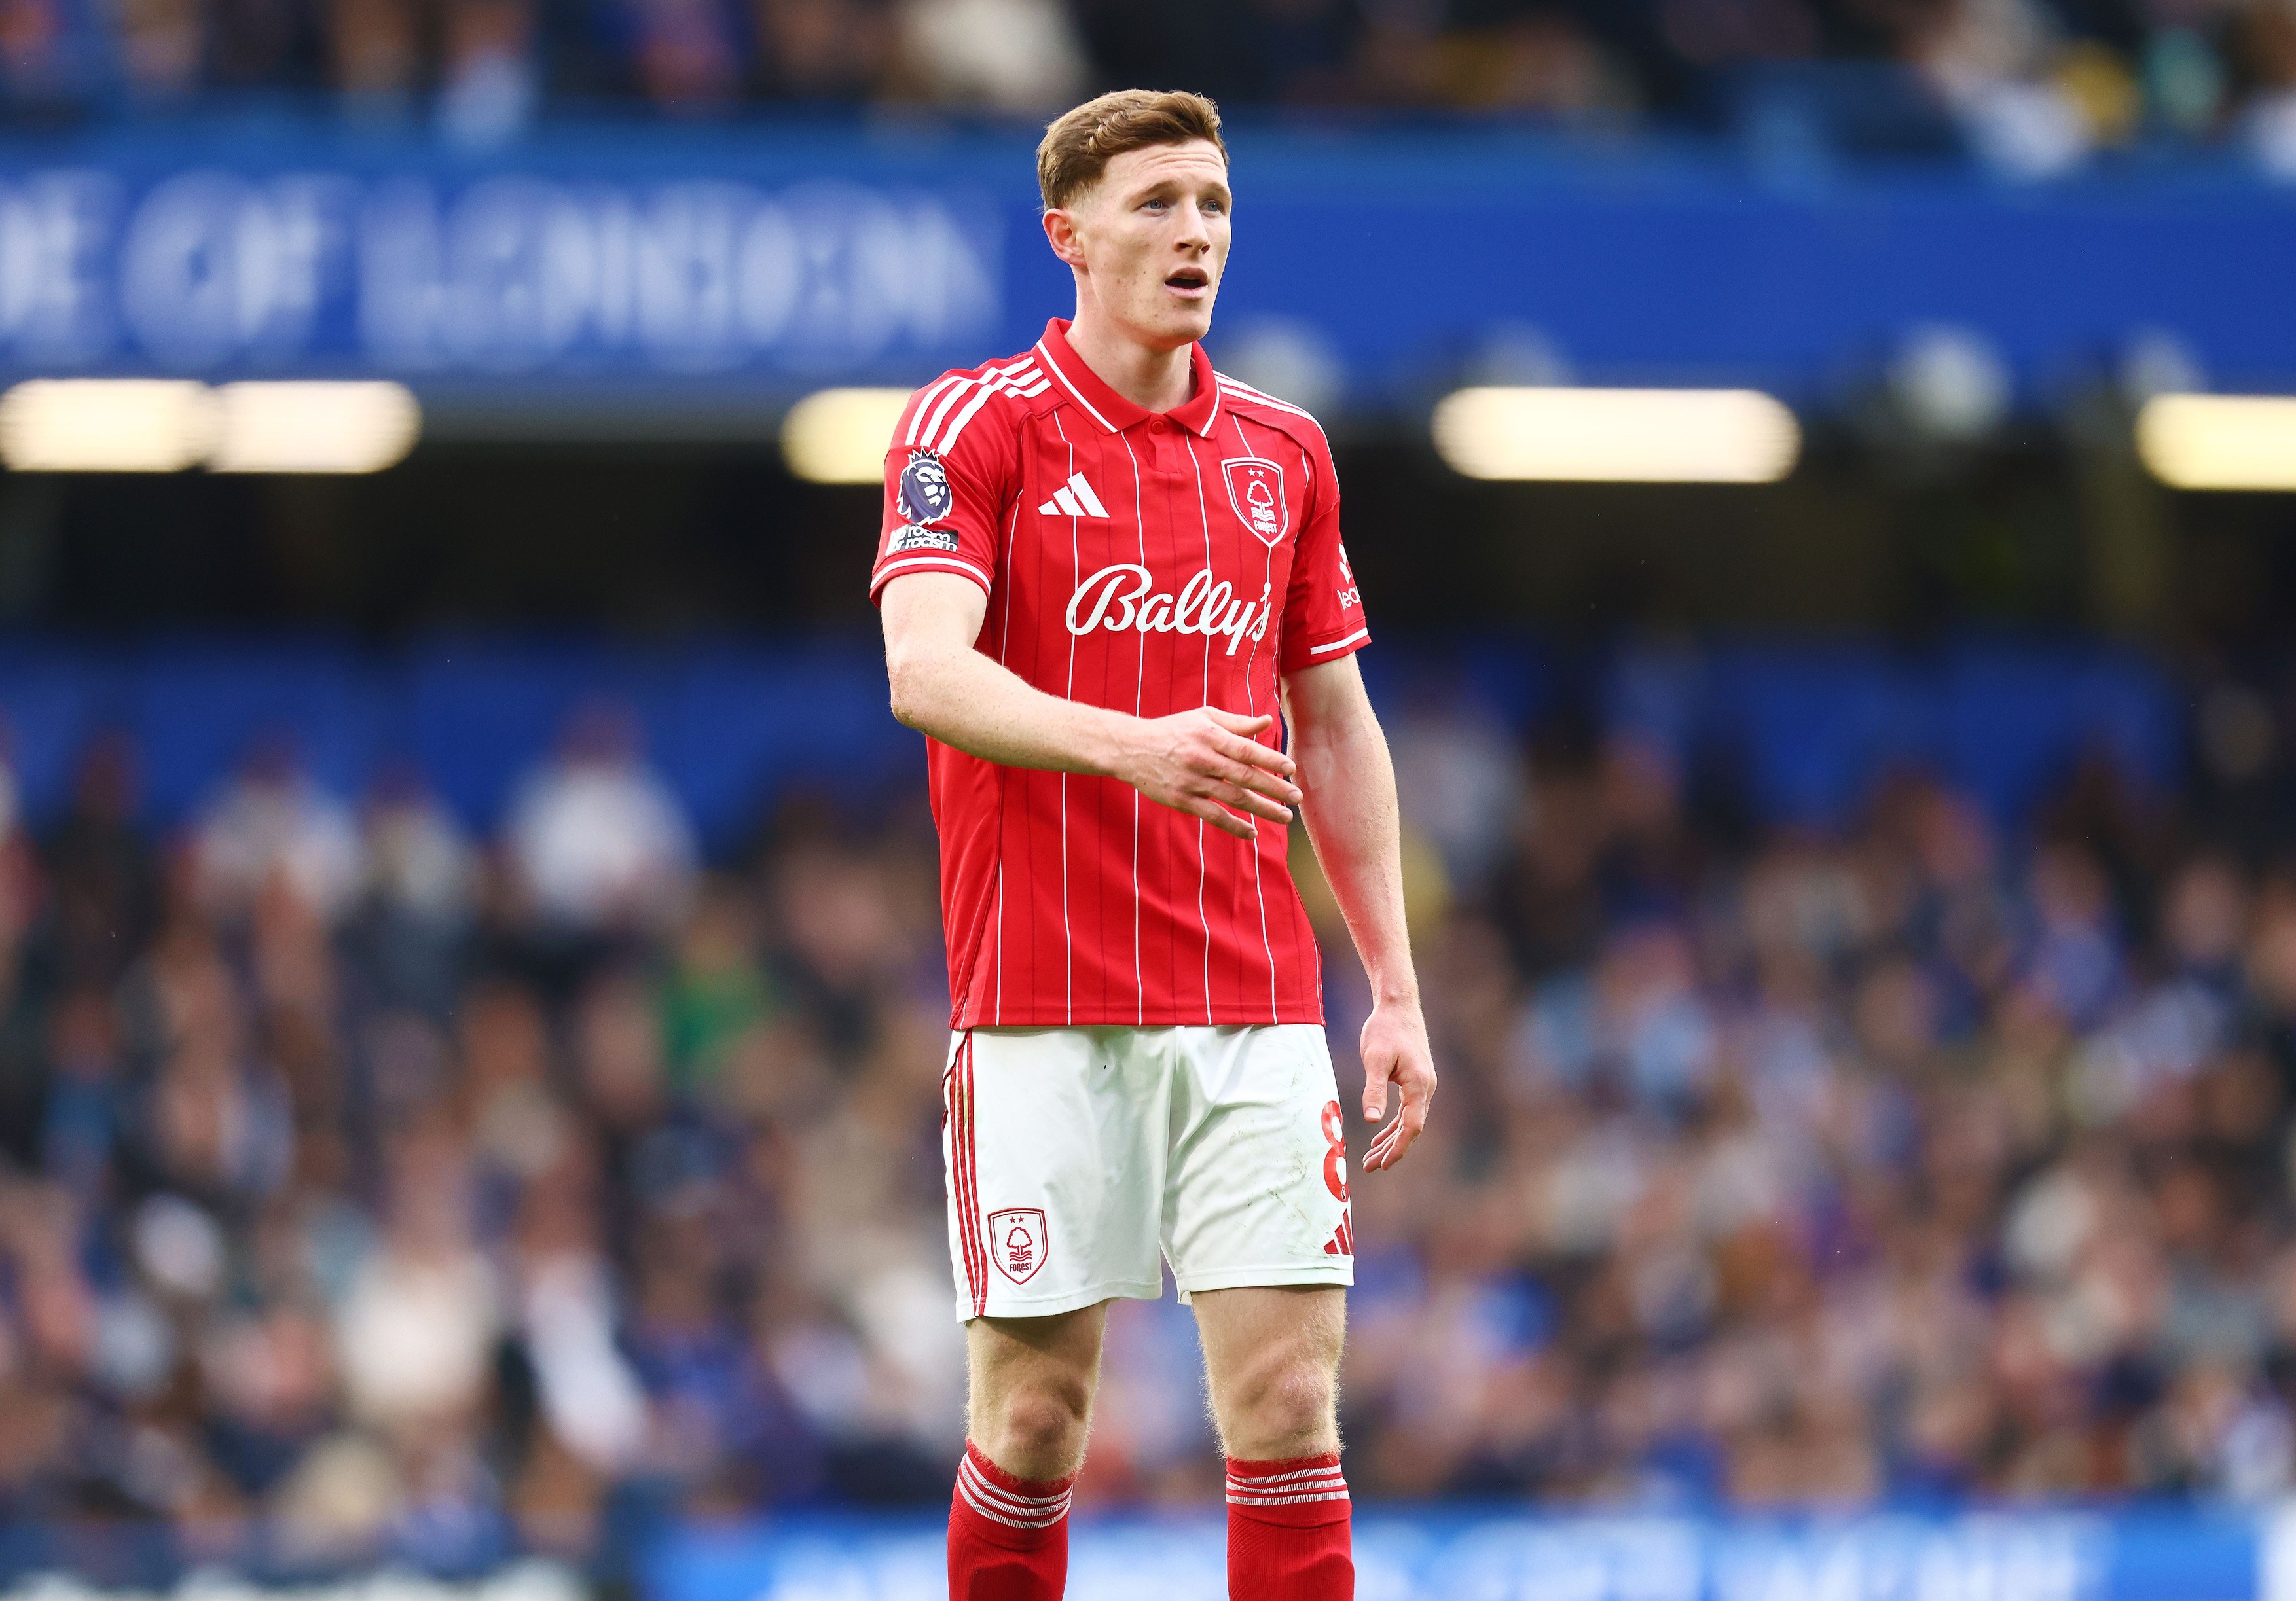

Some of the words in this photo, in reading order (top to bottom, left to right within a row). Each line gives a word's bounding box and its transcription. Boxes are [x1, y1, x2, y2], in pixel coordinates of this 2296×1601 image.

[905, 537, 957, 552] racism
[908, 526, 951, 543] room
[1066, 564, 1271, 656] Bally's
[1336, 586, 1361, 611] lea
[1321, 1100, 1349, 1202] 8
